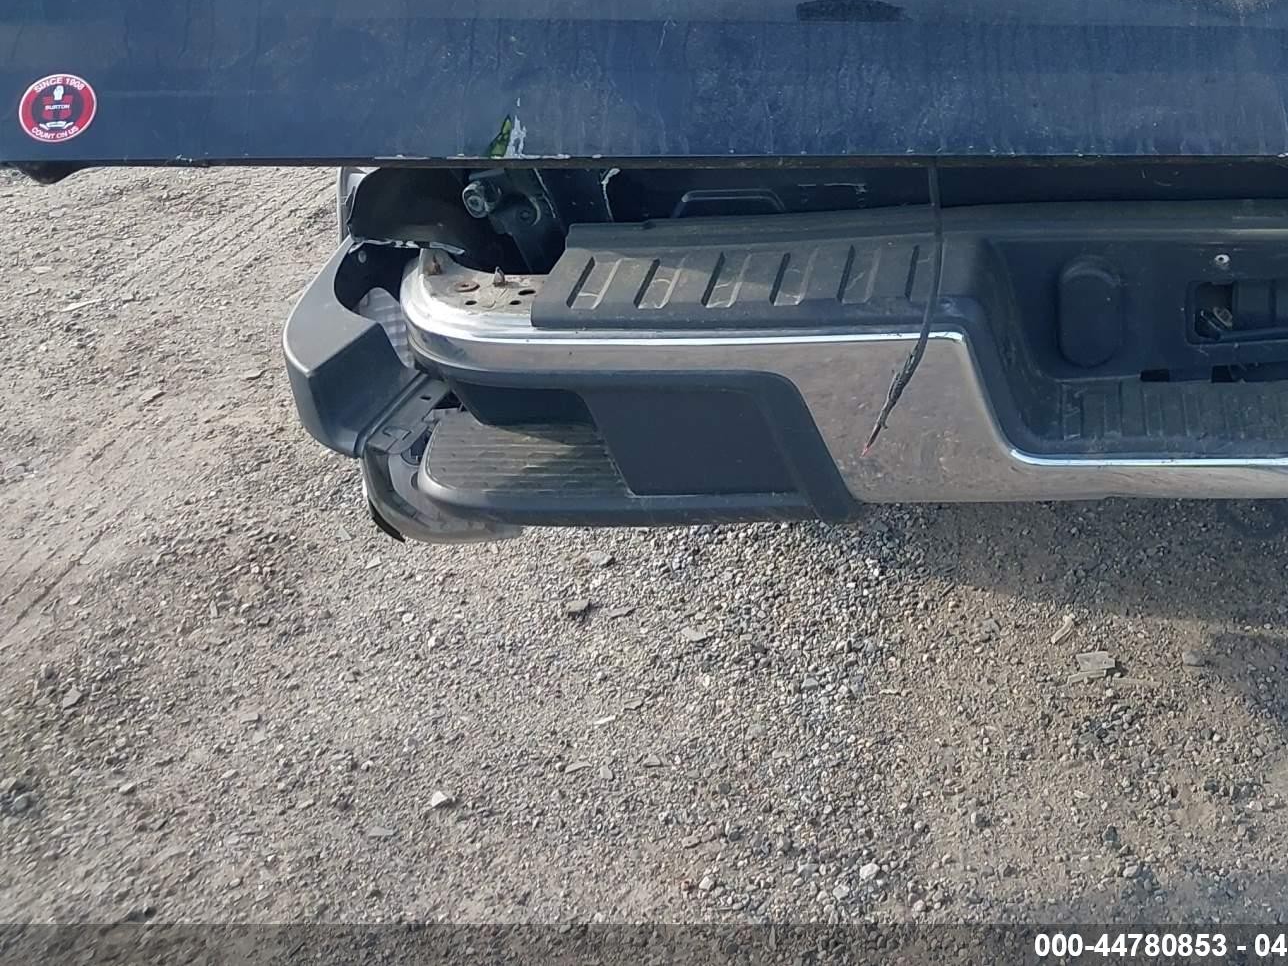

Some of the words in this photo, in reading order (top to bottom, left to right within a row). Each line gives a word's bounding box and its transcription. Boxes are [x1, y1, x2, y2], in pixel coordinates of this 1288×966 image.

[33, 77, 62, 93] SINCE
[31, 126, 56, 139] COUNT
[56, 130, 67, 139] ON
[68, 125, 79, 135] US
